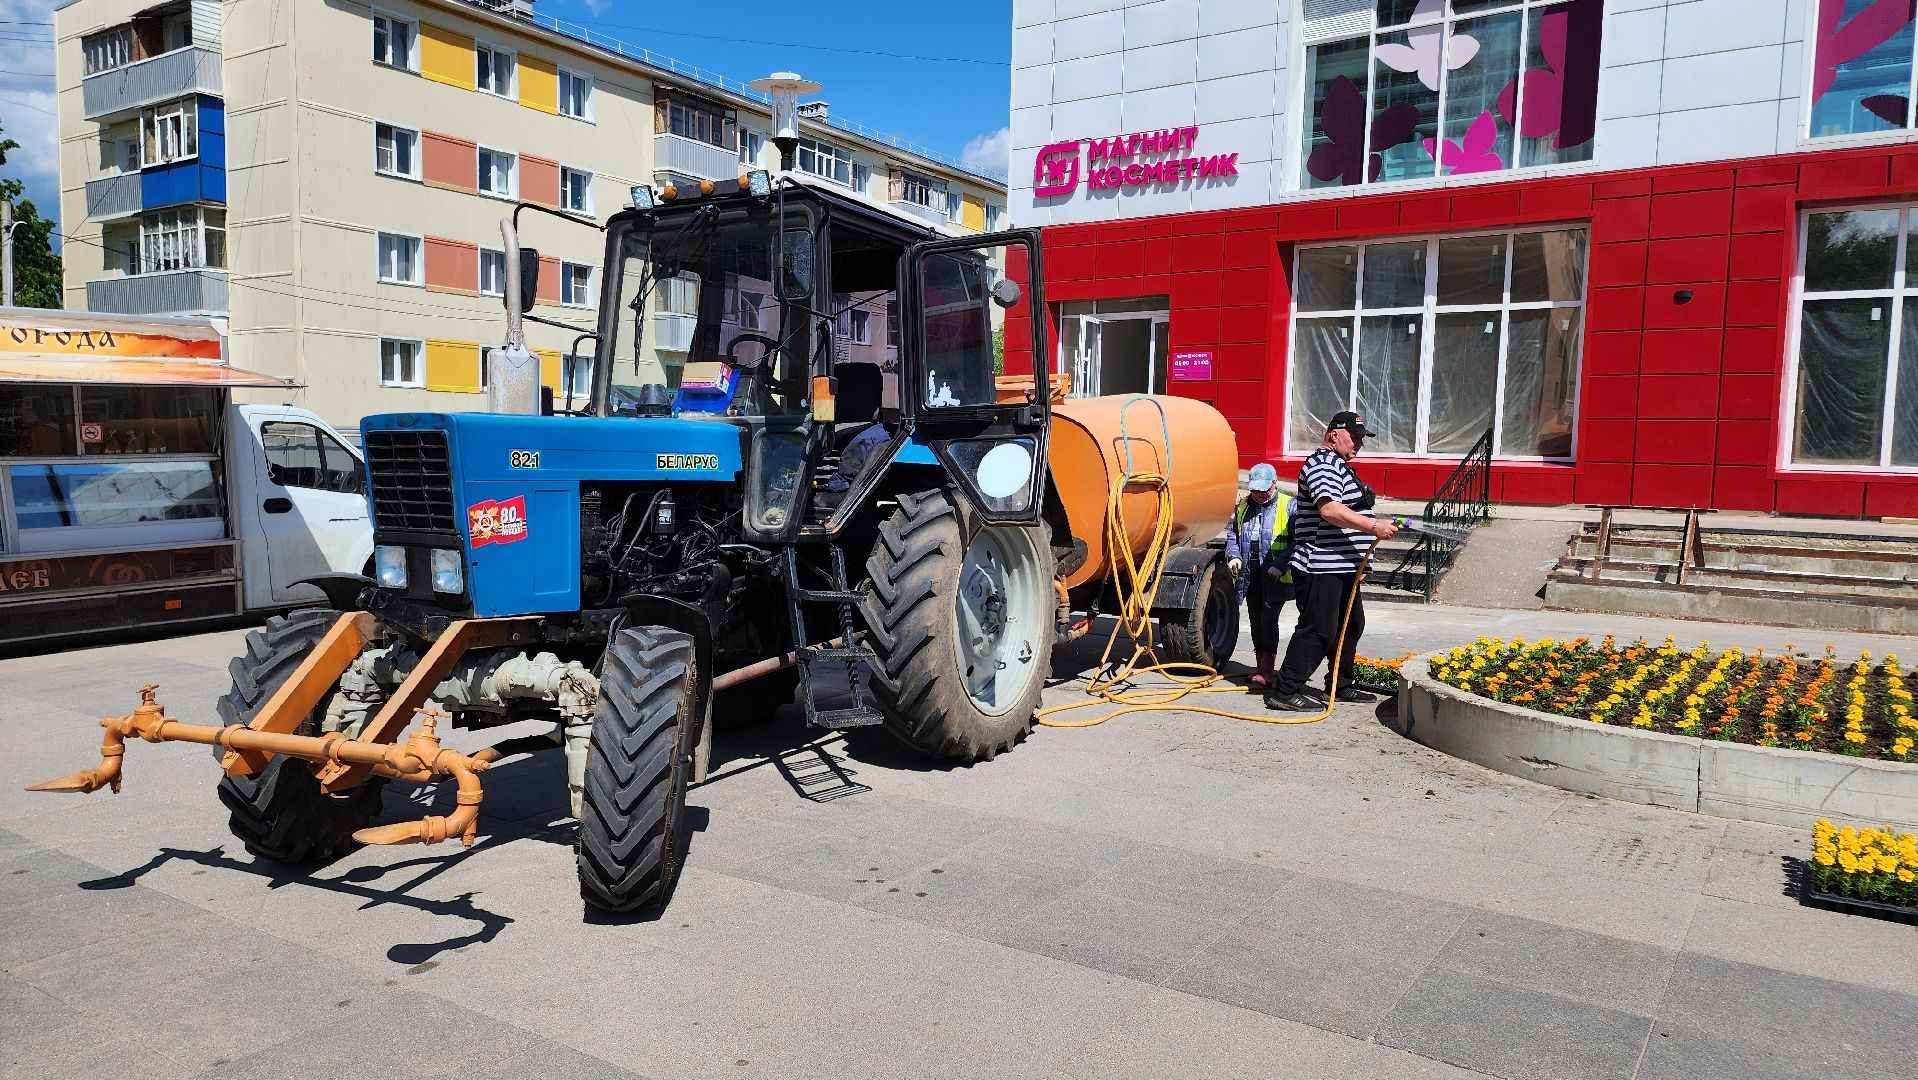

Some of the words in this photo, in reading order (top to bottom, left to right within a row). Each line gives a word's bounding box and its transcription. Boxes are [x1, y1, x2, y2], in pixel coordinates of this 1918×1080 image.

[1089, 127, 1199, 161] МАГНИТ
[1088, 153, 1239, 189] КОСМЕТИК
[511, 451, 540, 468] 82.1
[656, 454, 719, 469] БЕЛАРУС
[501, 506, 517, 523] 80
